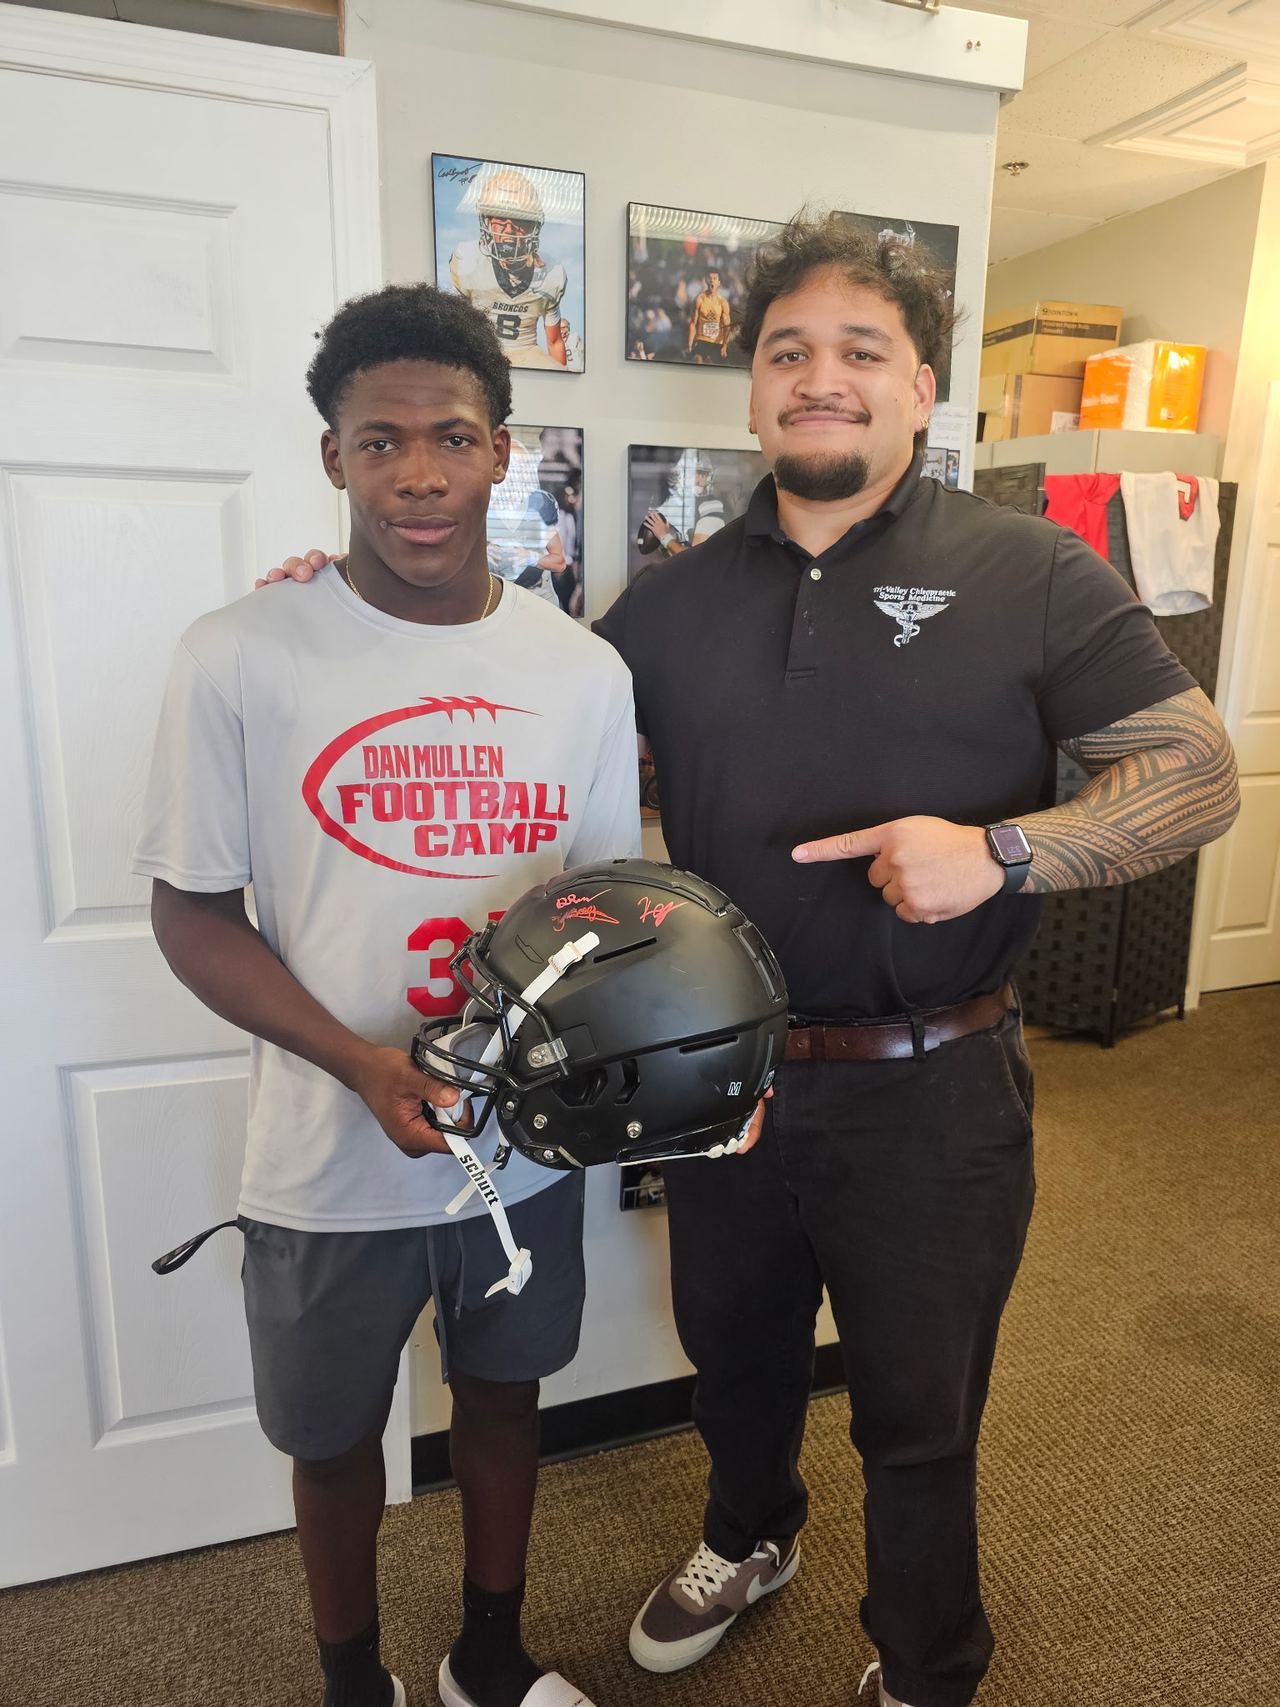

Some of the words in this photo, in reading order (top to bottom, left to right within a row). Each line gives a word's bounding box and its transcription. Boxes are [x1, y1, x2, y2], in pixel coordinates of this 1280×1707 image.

[492, 301, 530, 313] BRONCOS
[879, 592, 905, 600] Sports
[908, 594, 946, 602] Medicine
[909, 587, 957, 597] Chiropractic
[362, 745, 412, 779] DAN
[412, 745, 504, 779] MULLEN
[335, 781, 569, 824] FOOTBALL
[413, 823, 558, 857] CAMP
[459, 1154, 499, 1207] schutt
